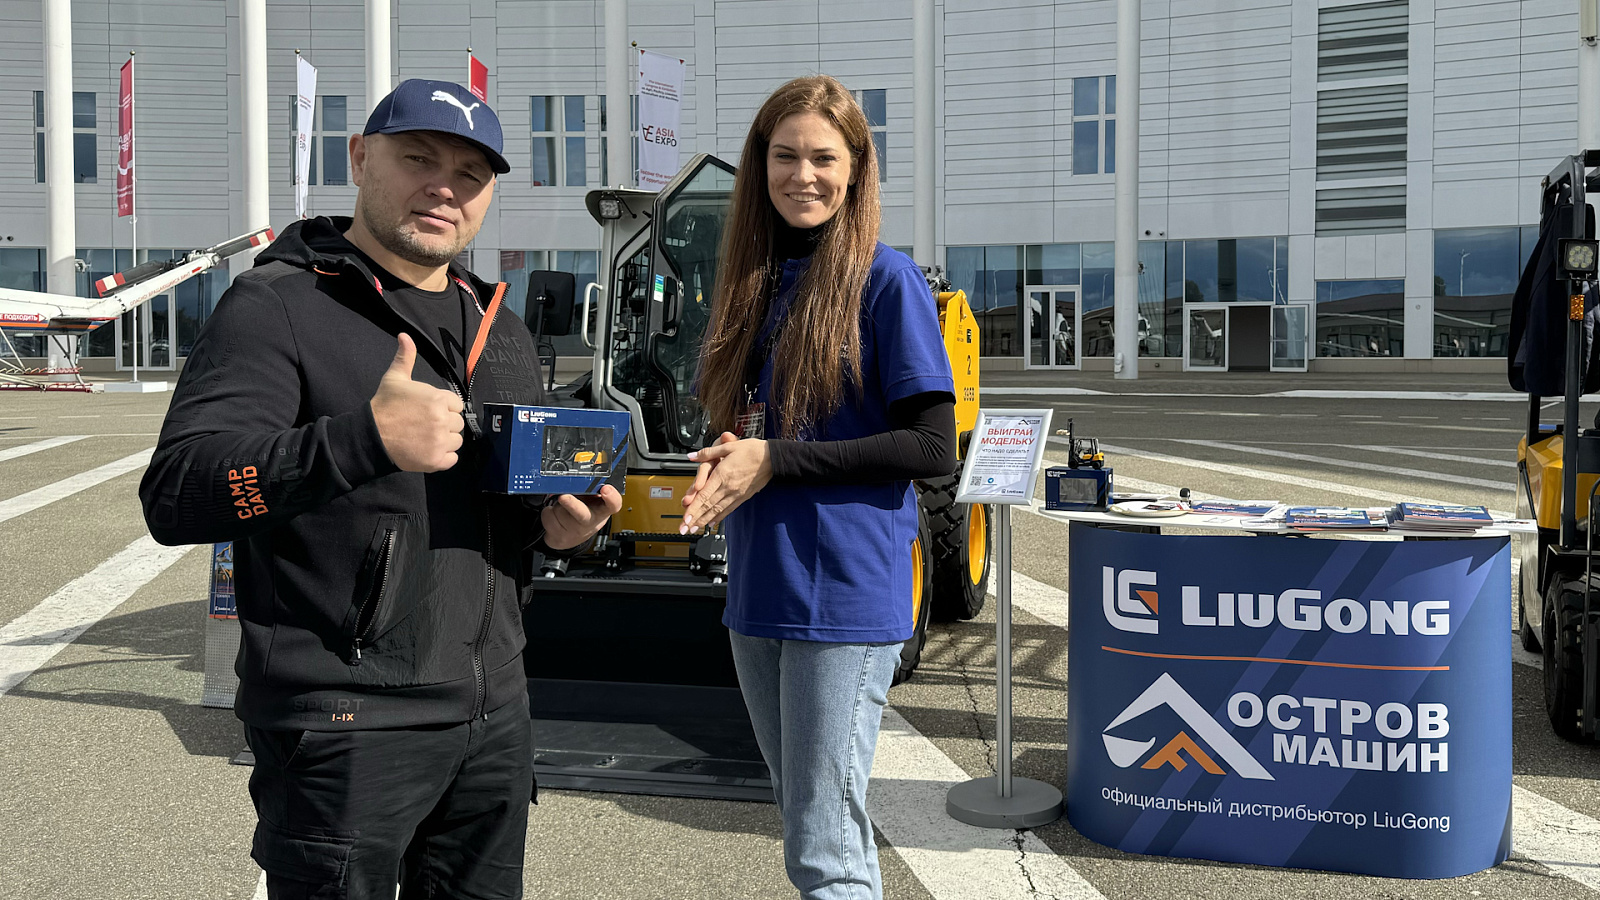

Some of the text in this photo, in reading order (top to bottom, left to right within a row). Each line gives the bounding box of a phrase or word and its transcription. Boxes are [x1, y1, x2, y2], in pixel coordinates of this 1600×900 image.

[656, 127, 674, 138] ASIA
[655, 136, 677, 147] EXPO
[4, 313, 38, 322] ПОДХОДИТЬ
[987, 427, 1033, 436] ВЫИГРАЙ
[980, 437, 1035, 446] МОДЕЛЬКУ
[228, 469, 253, 520] CAMP
[242, 465, 270, 516] DAVID
[294, 699, 363, 712] SPORT
[1227, 692, 1450, 739] ОСТРОВ
[1273, 733, 1449, 773] МАШИН
[1101, 787, 1450, 833] официальный дистрибьютор LiuGong
